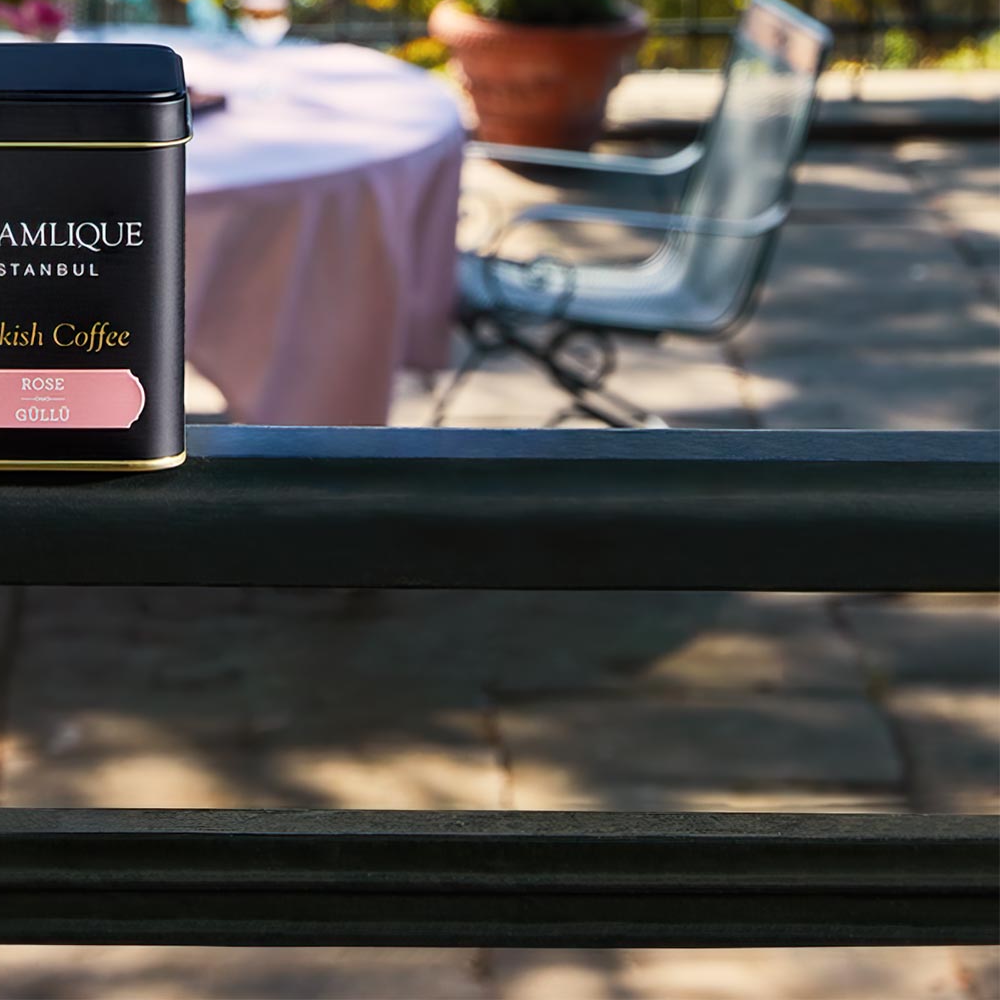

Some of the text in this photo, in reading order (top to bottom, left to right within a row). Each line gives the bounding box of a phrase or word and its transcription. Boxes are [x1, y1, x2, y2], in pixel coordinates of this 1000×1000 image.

[53, 322, 130, 352] Coffee
[21, 377, 65, 391] ROSE
[15, 406, 70, 422] GÜLLÜ
